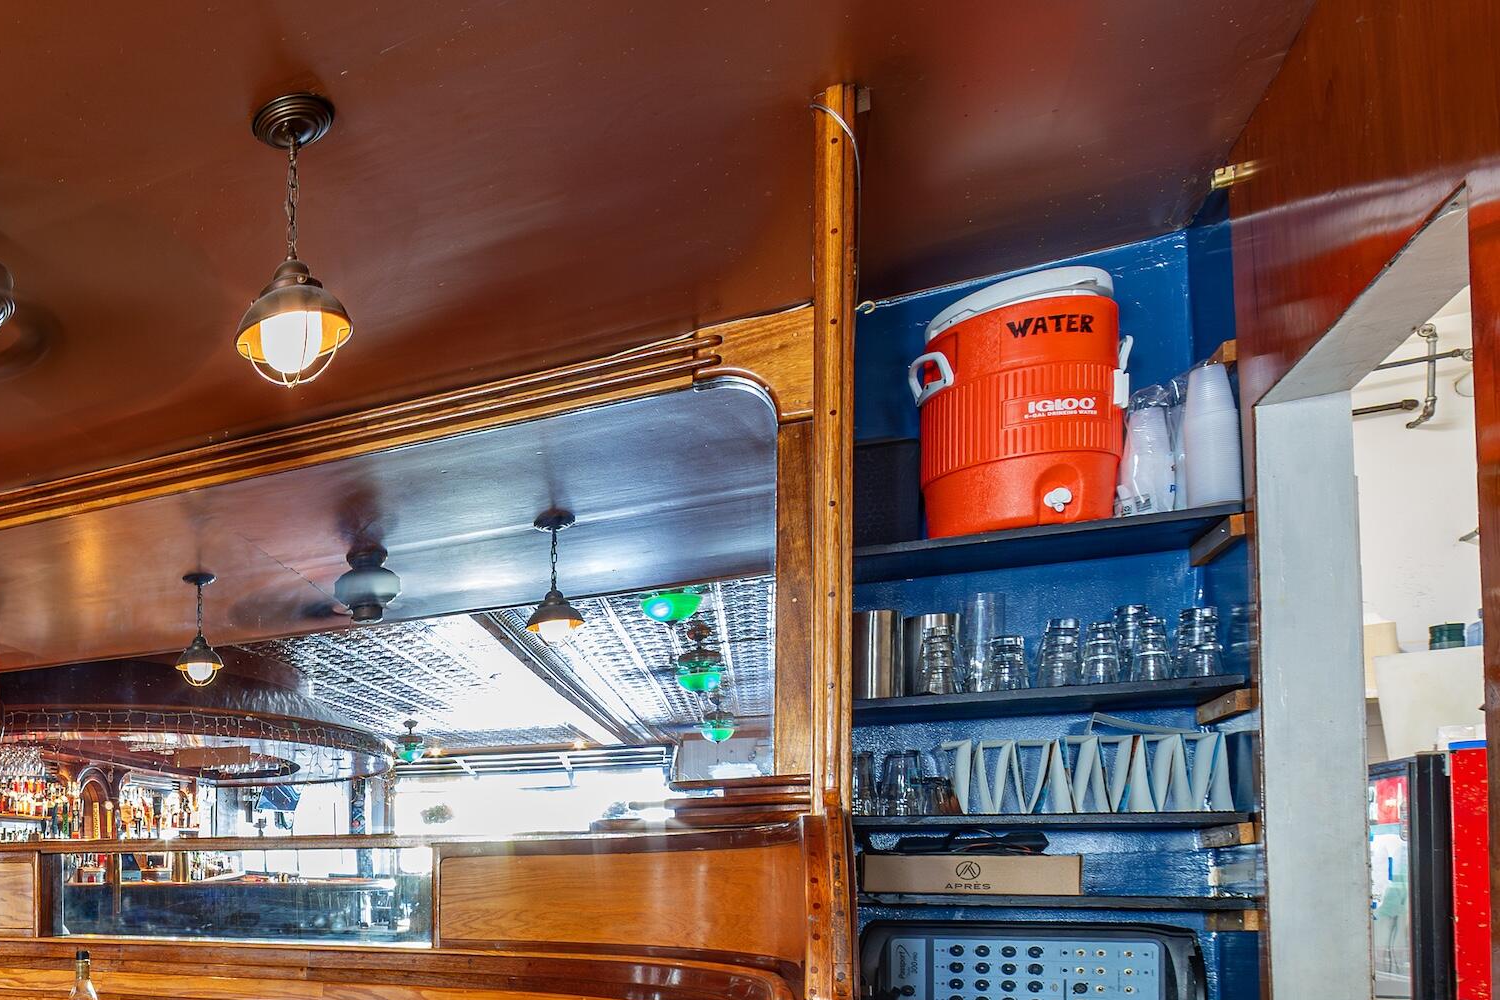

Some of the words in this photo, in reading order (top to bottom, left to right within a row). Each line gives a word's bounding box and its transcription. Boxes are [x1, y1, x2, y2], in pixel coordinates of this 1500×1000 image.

[1006, 314, 1094, 338] WATER
[1028, 398, 1096, 413] IGLOO
[945, 881, 991, 890] APRÈS
[898, 951, 906, 979] Passport
